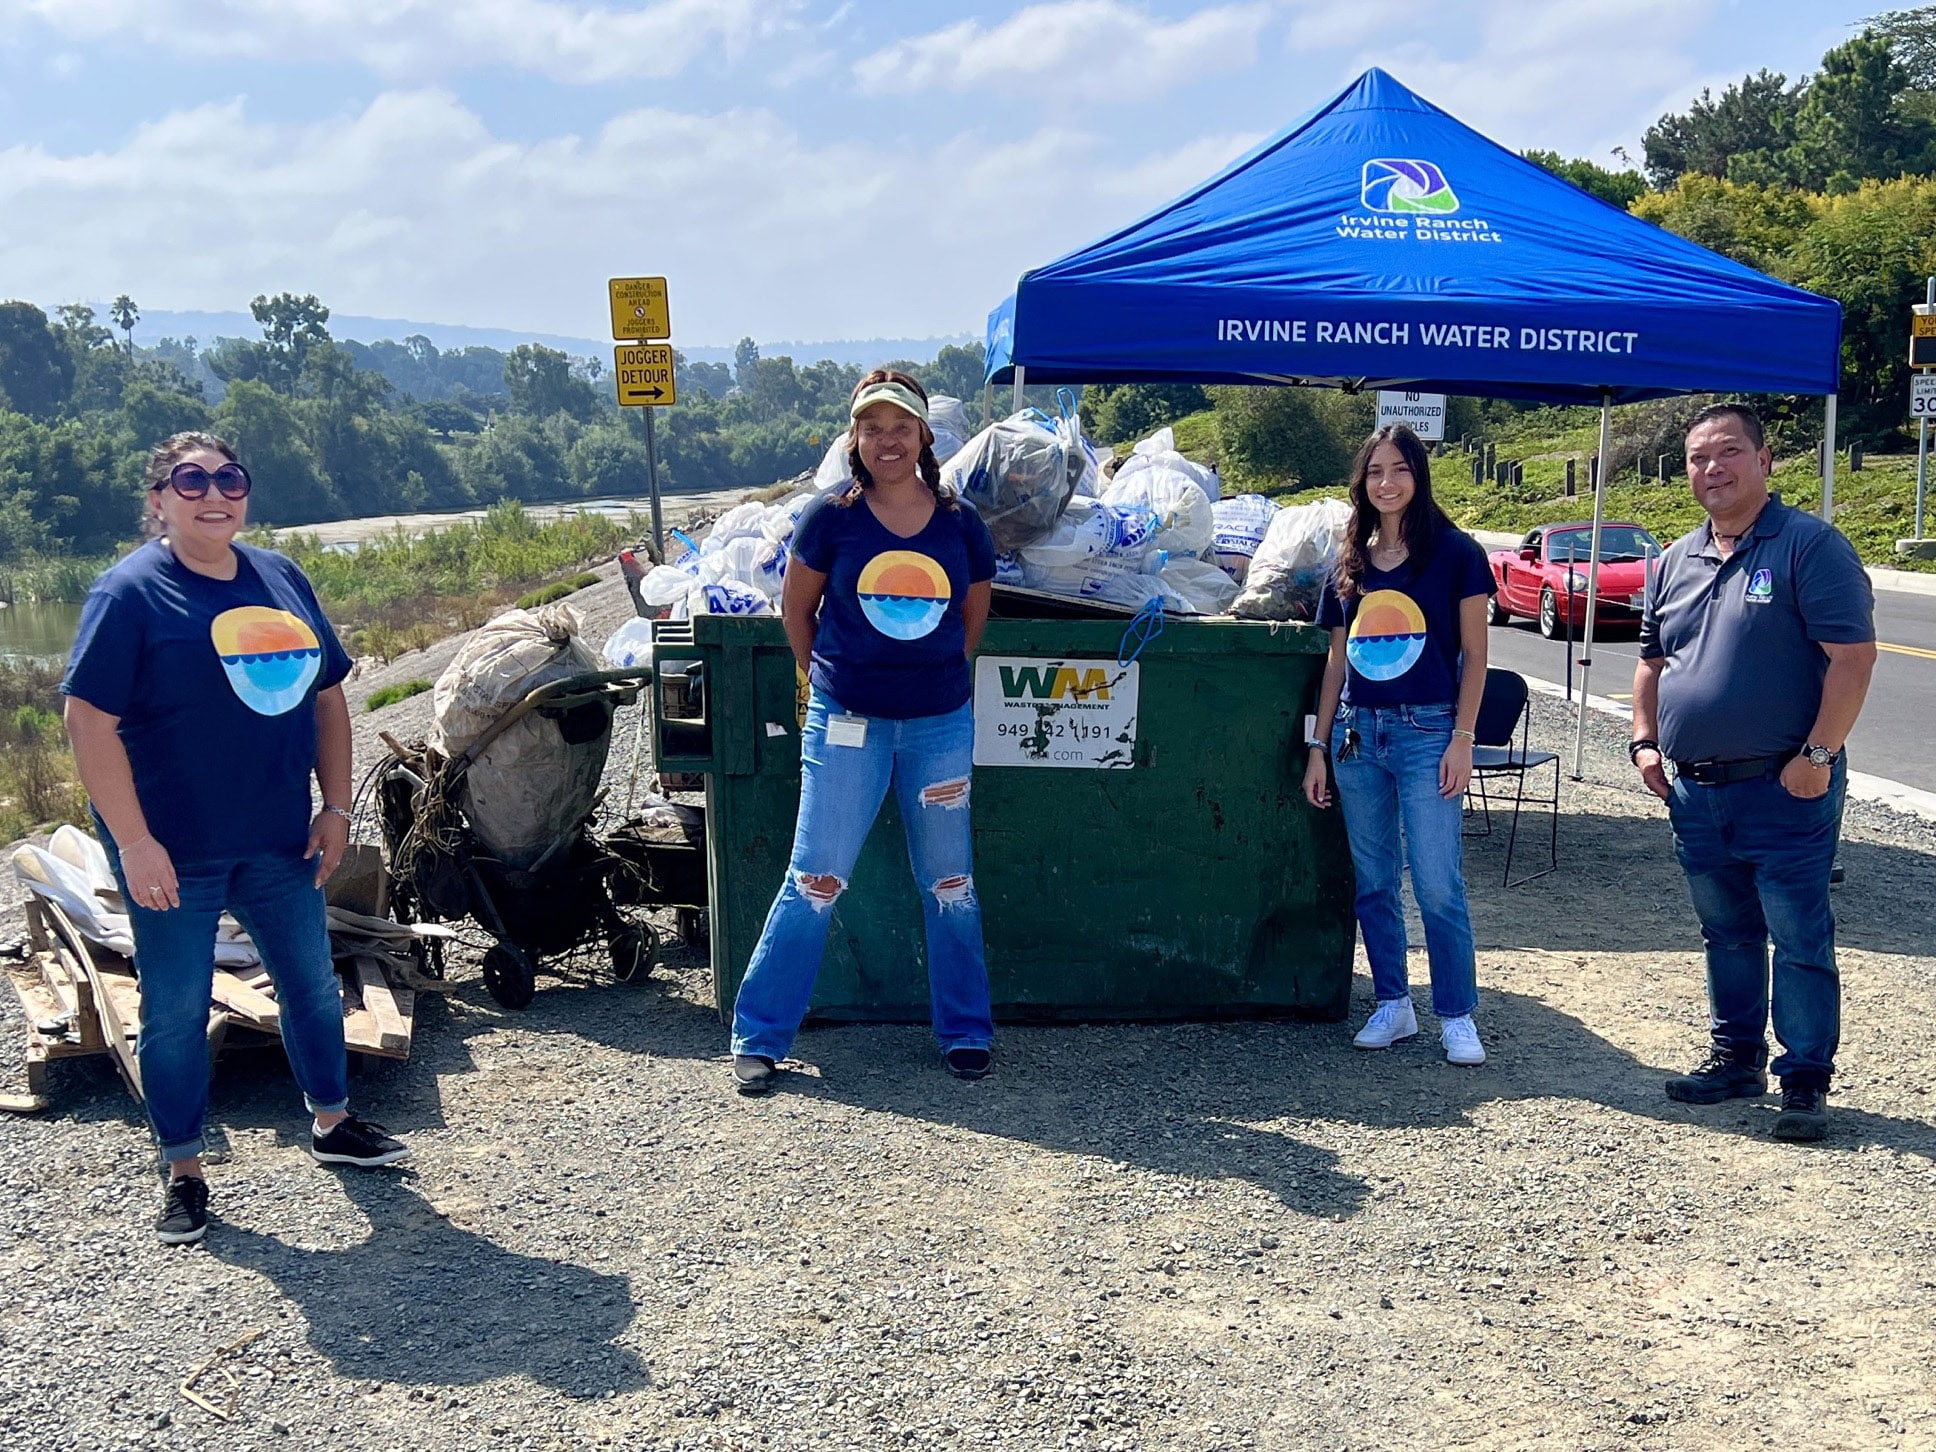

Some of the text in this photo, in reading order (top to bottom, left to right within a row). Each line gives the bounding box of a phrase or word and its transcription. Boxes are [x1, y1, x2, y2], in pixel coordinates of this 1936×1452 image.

[1341, 214, 1489, 230] Irvine Ranch
[1336, 226, 1502, 242] Water District
[615, 290, 662, 299] CONSTRUCTION
[627, 318, 655, 326] JOGGERS
[622, 326, 660, 334] PROHIBITED
[1217, 319, 1639, 354] IRVINE RANCH WATER DISTRICT
[621, 350, 668, 365] JOGGER
[622, 369, 668, 384] DETOUR
[1405, 391, 1420, 402] NO
[1381, 405, 1442, 417] UNAUTHORIZED
[999, 666, 1110, 700] WM
[998, 723, 1029, 736] 949
